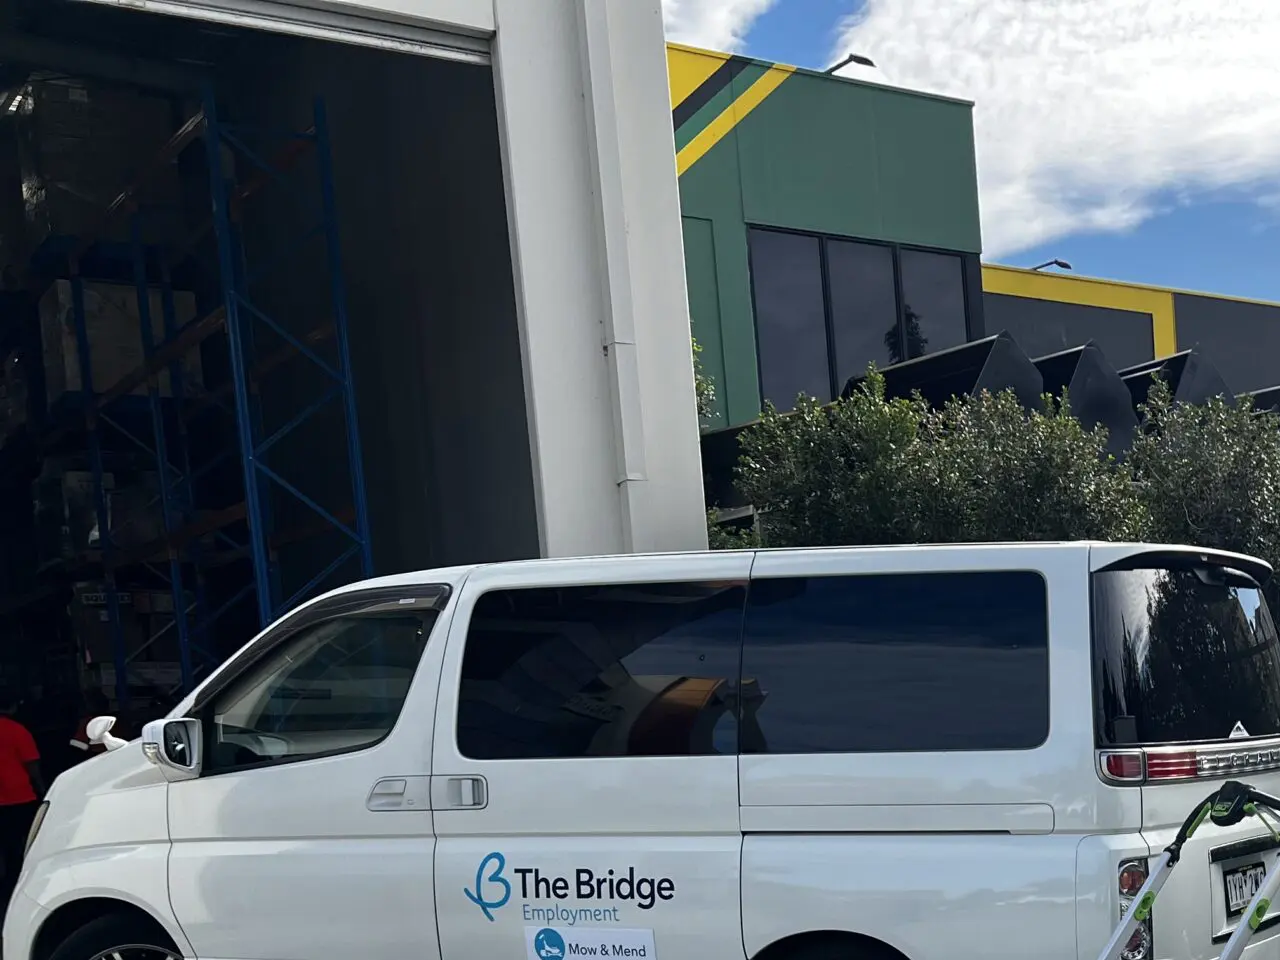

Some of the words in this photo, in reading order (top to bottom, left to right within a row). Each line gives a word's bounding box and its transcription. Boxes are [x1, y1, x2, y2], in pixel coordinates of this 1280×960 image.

[514, 868, 569, 900] The
[575, 866, 675, 909] Bridge
[523, 904, 620, 926] Employment
[568, 943, 598, 957] Mow
[600, 943, 610, 957] &
[612, 945, 646, 958] Mend
